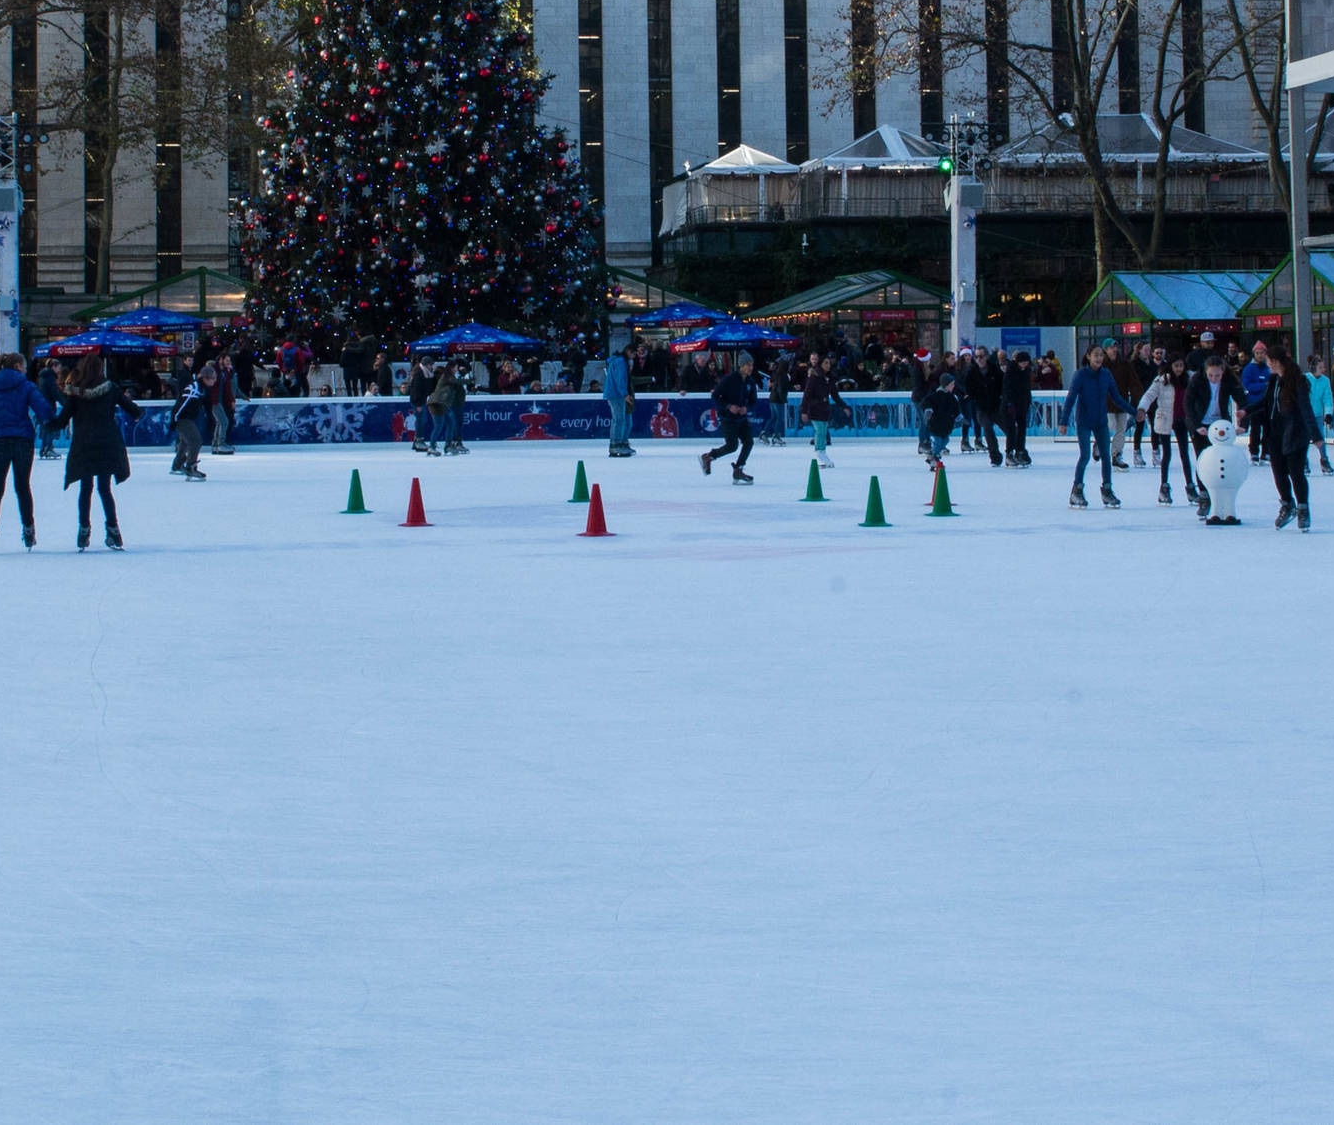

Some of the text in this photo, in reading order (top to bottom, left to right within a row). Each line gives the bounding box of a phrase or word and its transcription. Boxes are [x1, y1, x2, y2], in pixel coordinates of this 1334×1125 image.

[462, 408, 513, 425] gic hour
[560, 415, 612, 431] every ho
